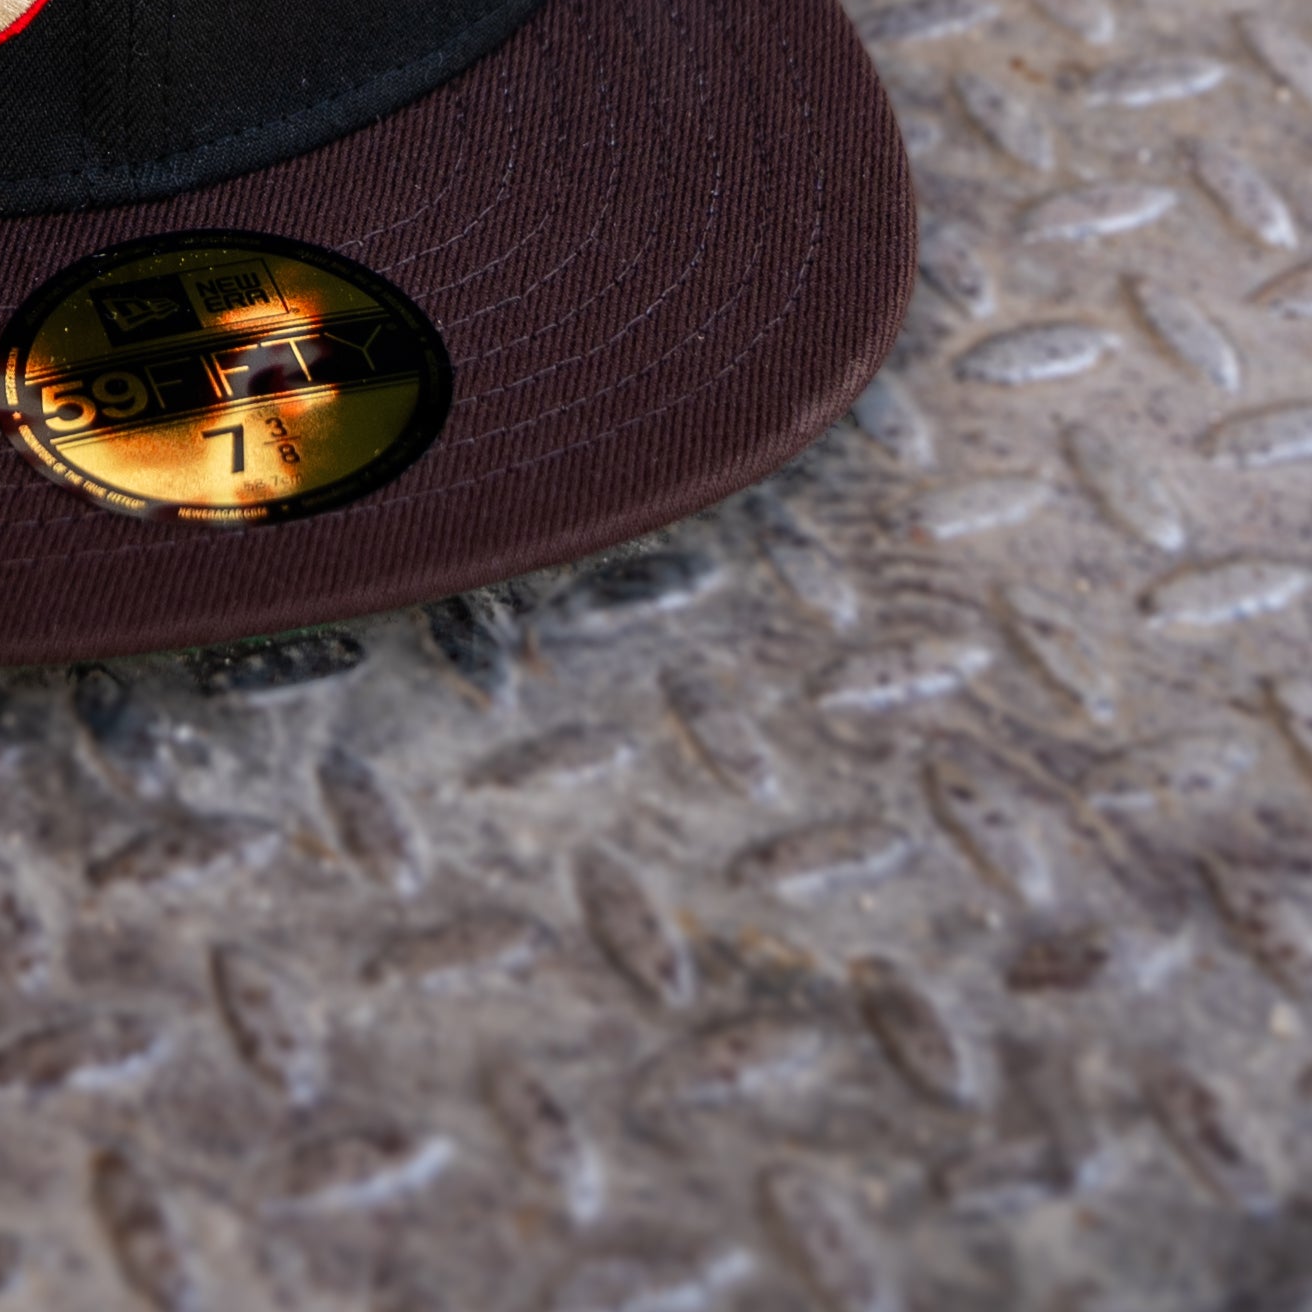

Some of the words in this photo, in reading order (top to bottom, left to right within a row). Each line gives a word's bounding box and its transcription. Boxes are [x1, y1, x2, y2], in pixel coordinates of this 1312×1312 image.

[195, 271, 261, 296] NEW
[204, 287, 270, 313] ERA
[41, 322, 382, 432] 59FIFTY
[201, 423, 245, 474] 7
